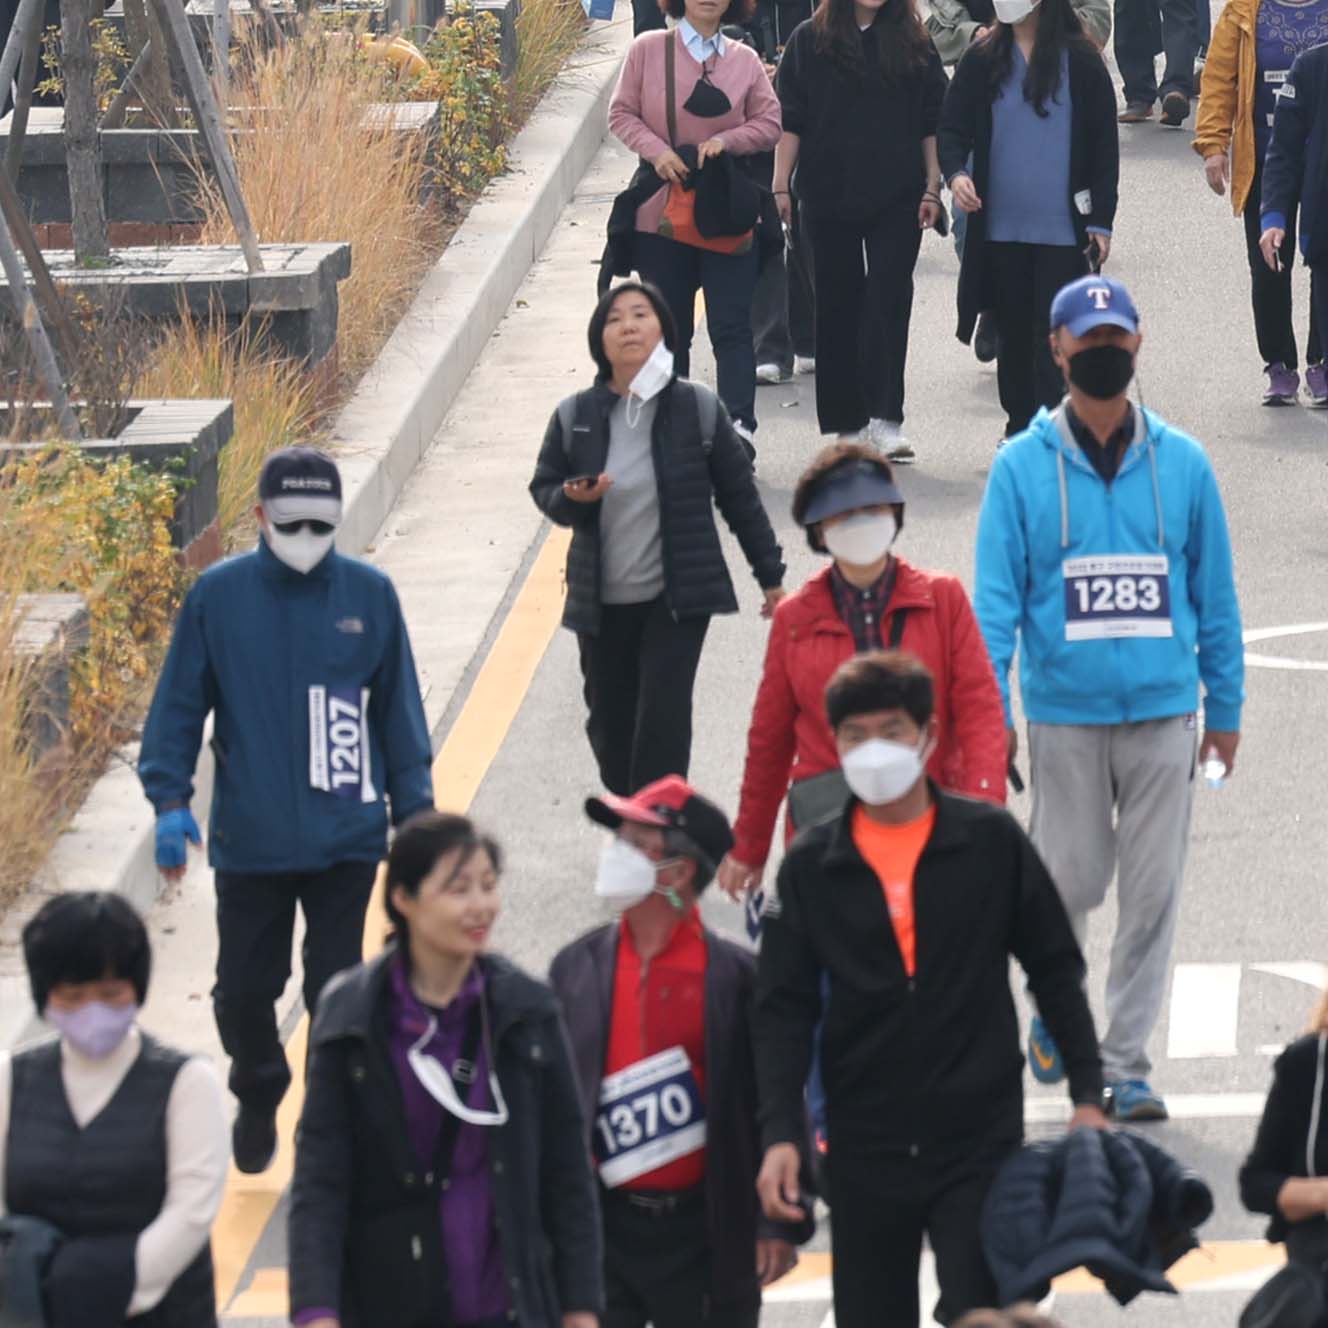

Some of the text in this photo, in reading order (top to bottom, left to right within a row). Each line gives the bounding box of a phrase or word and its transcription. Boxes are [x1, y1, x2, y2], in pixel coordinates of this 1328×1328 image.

[1087, 287, 1111, 309] T
[1074, 576, 1161, 613] 1283
[329, 696, 362, 789] 1207
[598, 1083, 692, 1154] 1370
